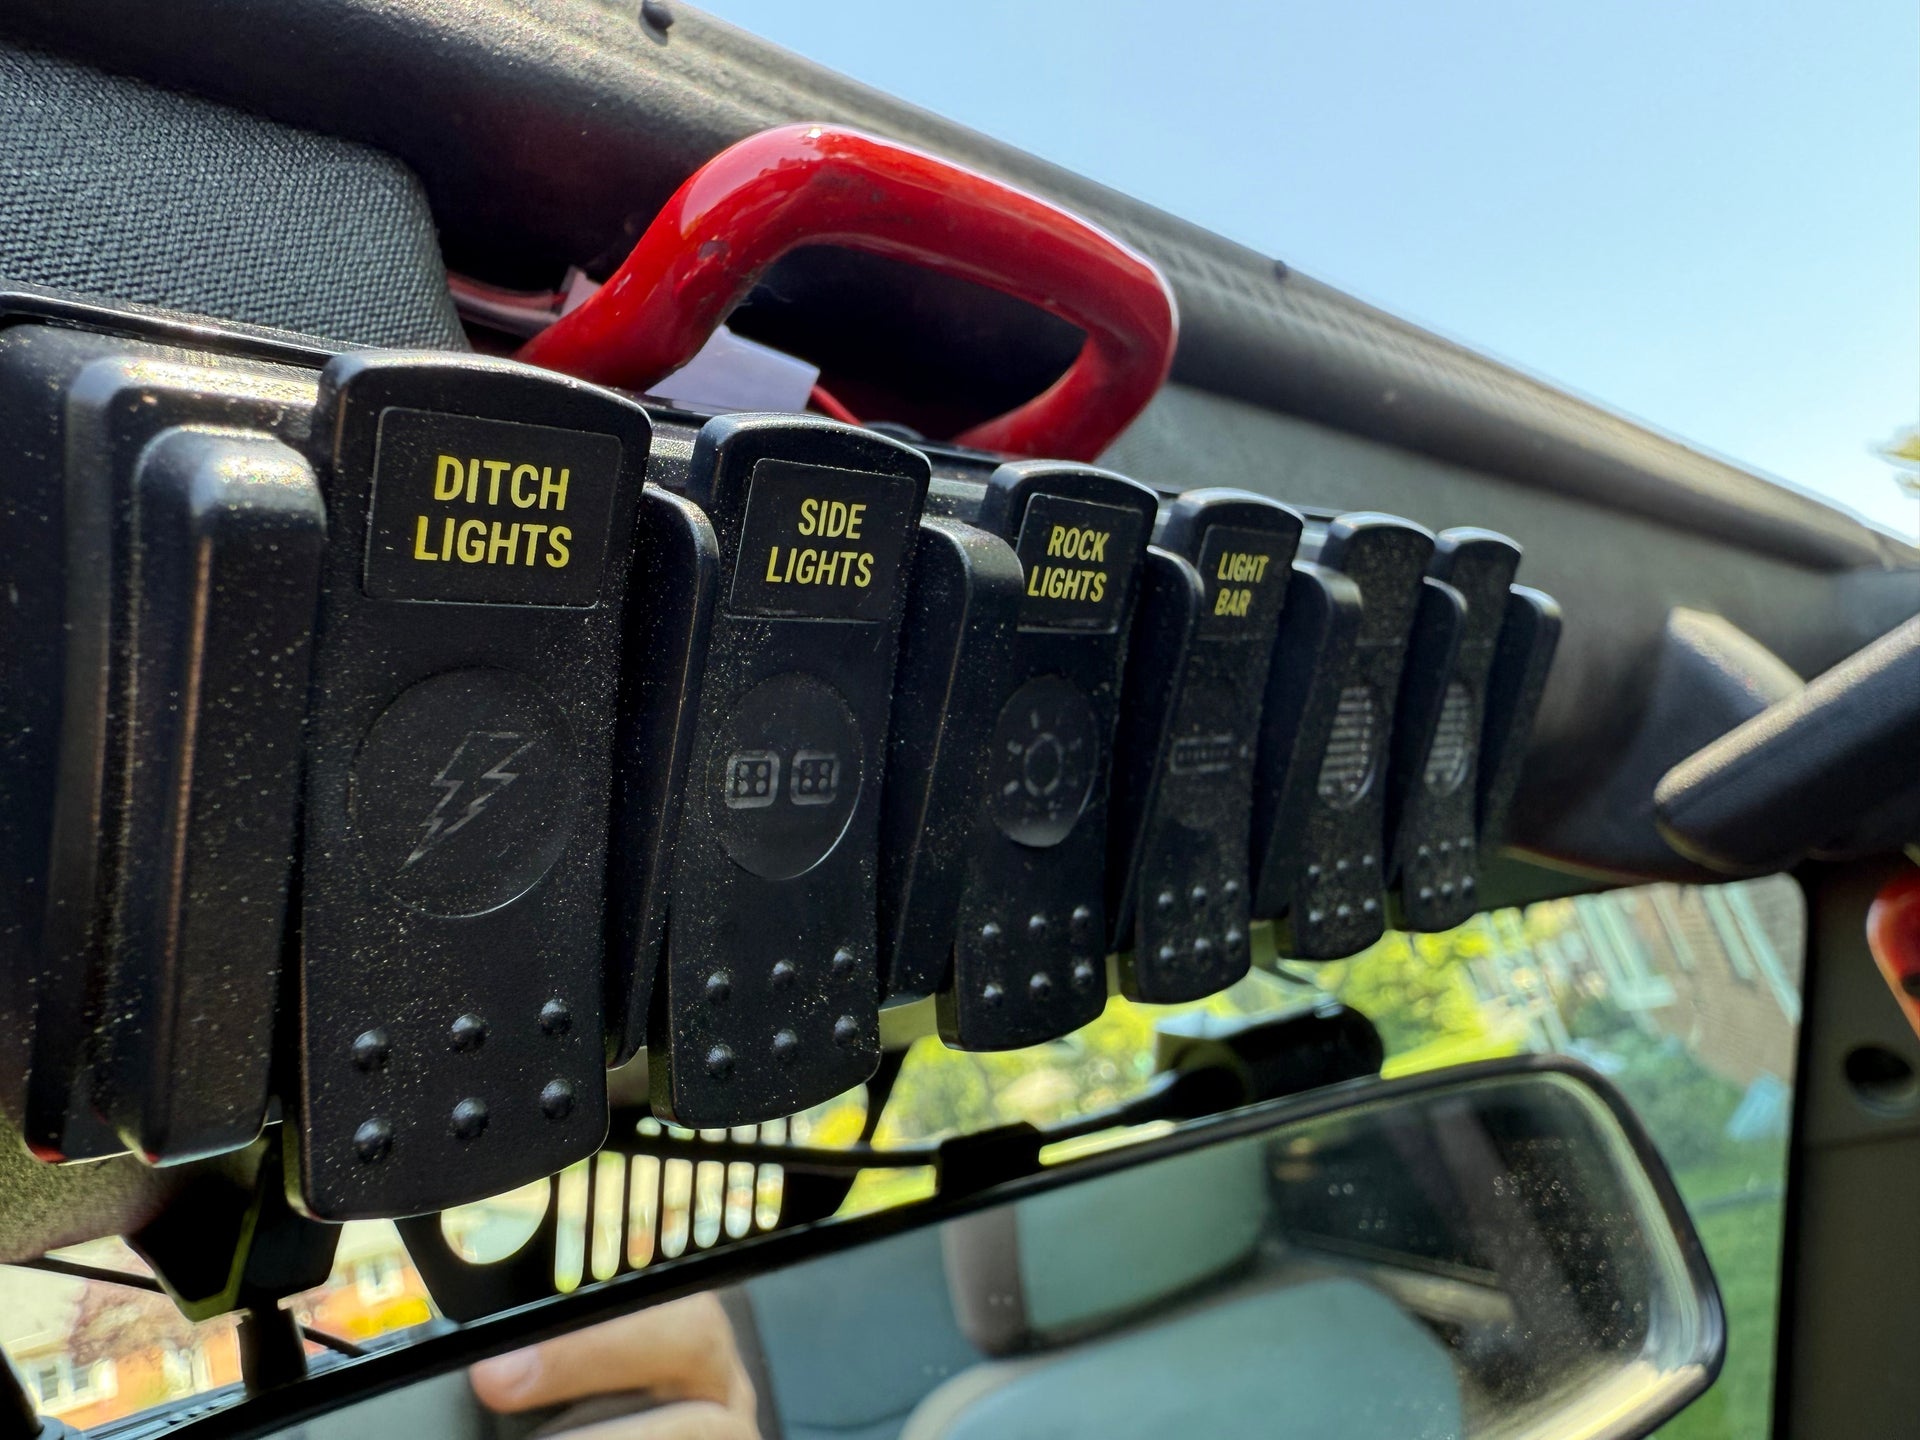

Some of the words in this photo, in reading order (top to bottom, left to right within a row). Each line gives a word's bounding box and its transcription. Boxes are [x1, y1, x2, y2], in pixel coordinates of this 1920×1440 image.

[433, 454, 570, 511] DITCH
[797, 497, 868, 540] SIDE
[414, 515, 573, 569] LIGHTS
[1047, 525, 1110, 562] ROCK
[765, 547, 875, 588] LIGHTS
[1027, 566, 1108, 603] LIGHTS
[1217, 552, 1270, 583] LIGHT
[1214, 588, 1252, 618] BAR
